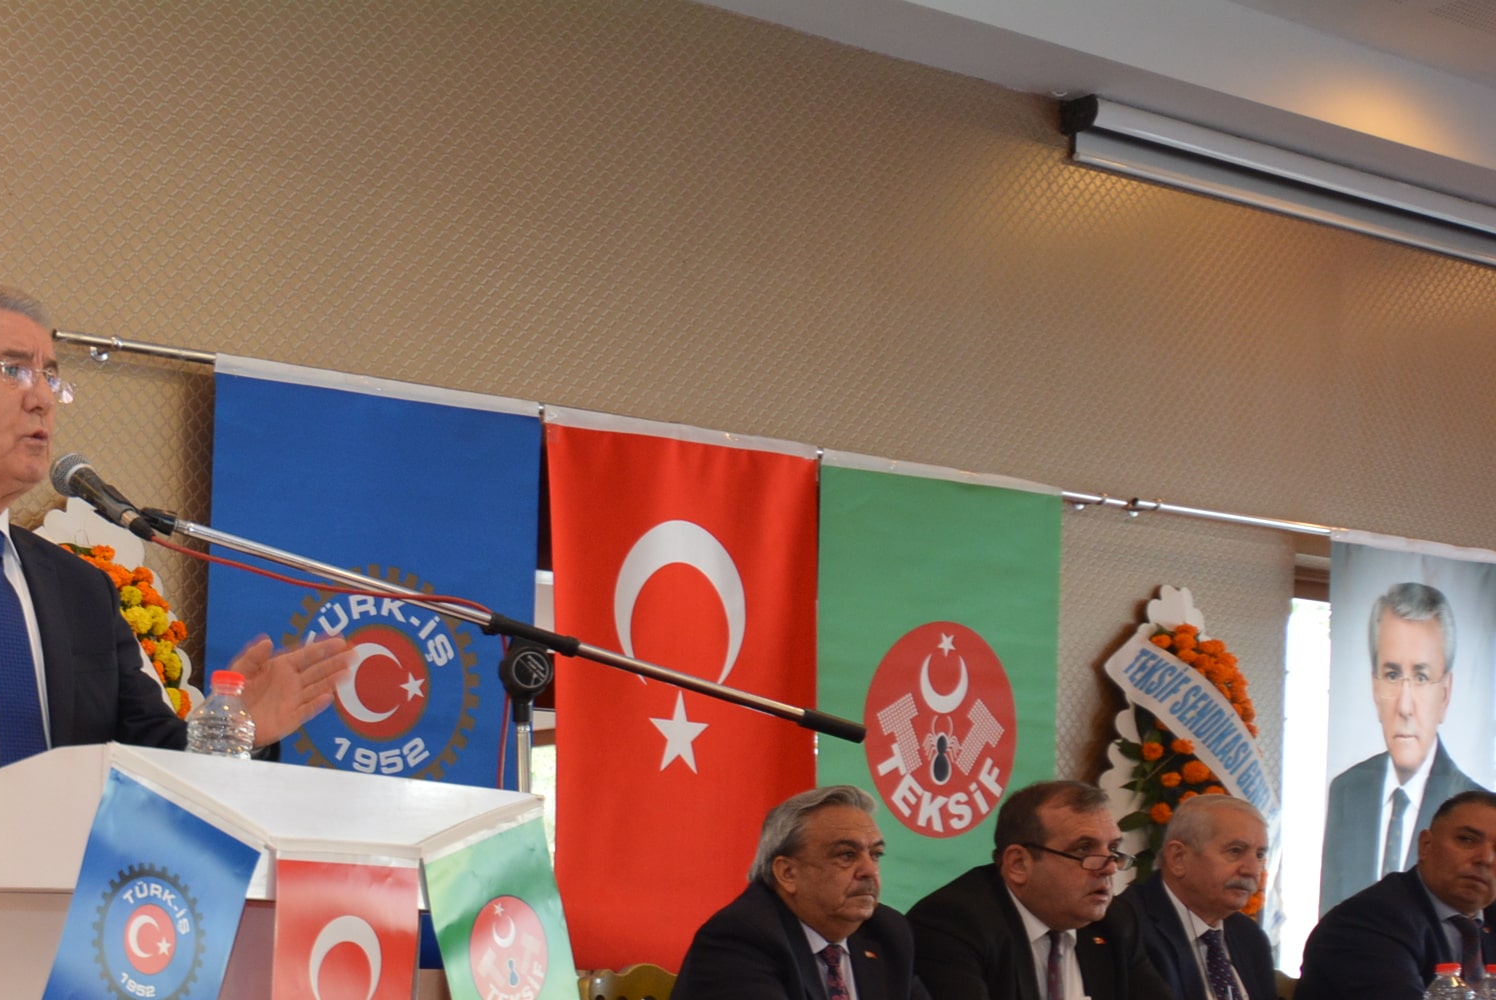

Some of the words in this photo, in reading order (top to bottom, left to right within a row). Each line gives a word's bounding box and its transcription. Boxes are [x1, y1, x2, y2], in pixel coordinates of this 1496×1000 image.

[1123, 648, 1191, 703] TEKSİF
[1169, 685, 1253, 776] SENDİKASI
[333, 737, 430, 774] 1952
[877, 743, 1004, 832] TEKSİF
[121, 972, 156, 997] 1952
